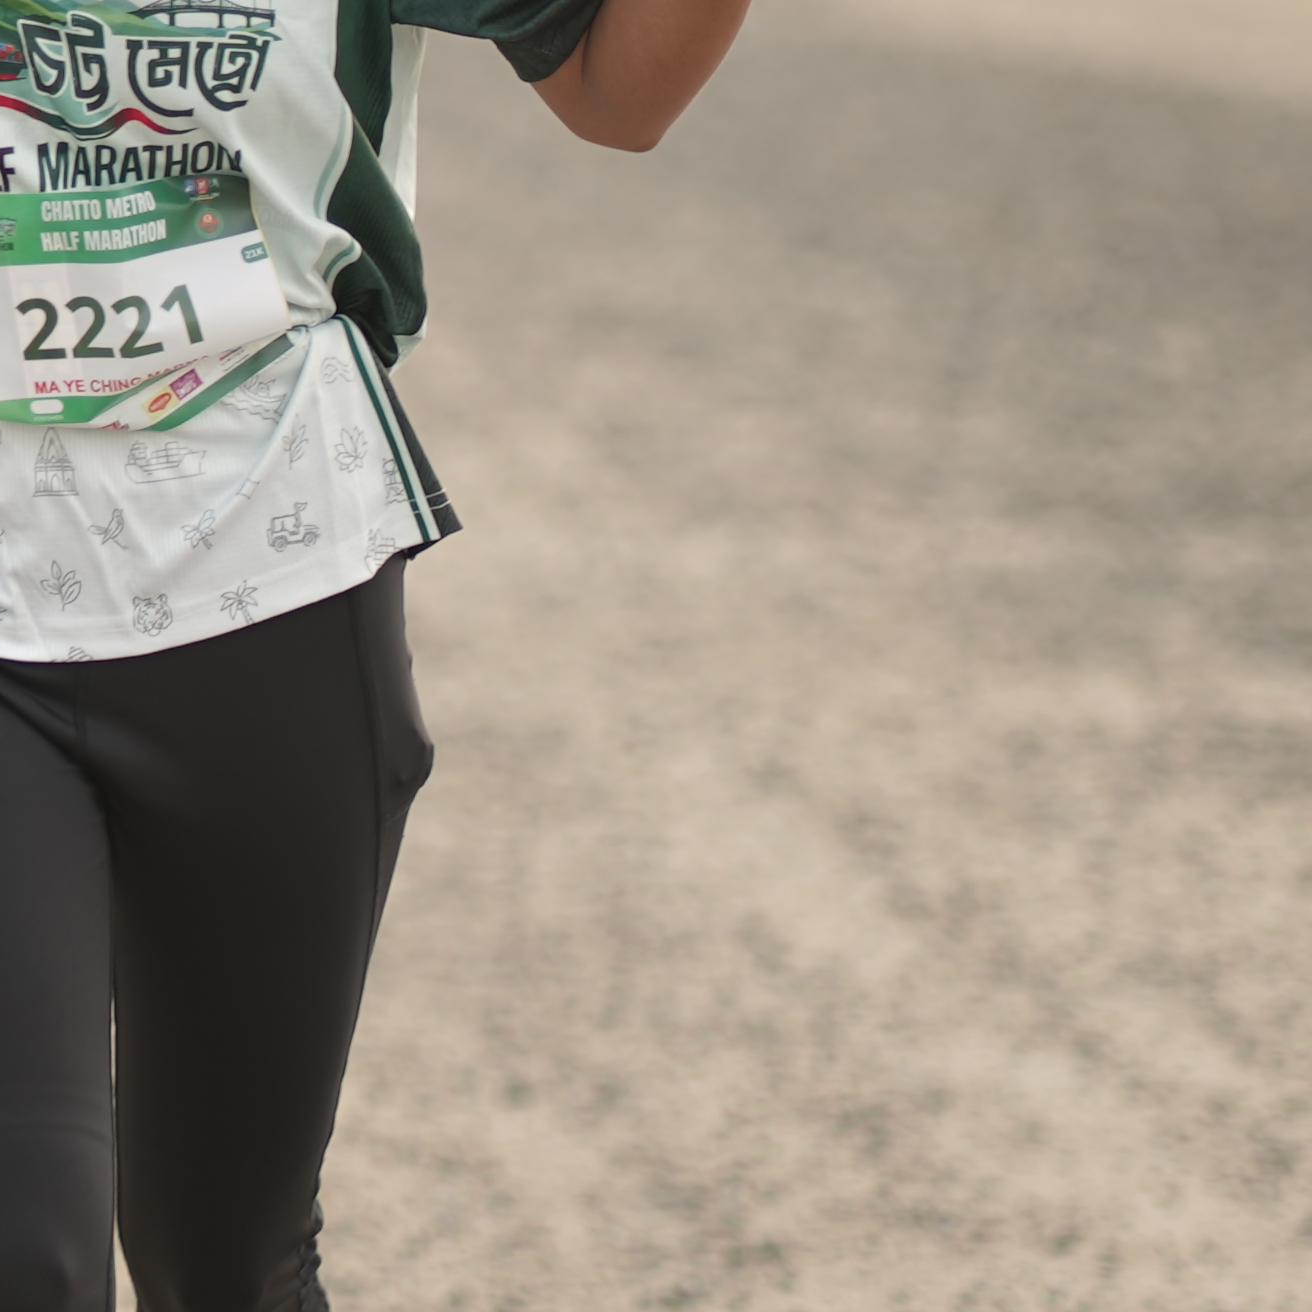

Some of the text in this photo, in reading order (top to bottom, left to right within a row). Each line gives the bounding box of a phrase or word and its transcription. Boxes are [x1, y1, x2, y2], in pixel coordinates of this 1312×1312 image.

[37, 140, 243, 192] MARATHON
[40, 191, 156, 222] CHATTO METRO
[40, 219, 167, 252] HALF MARATHON
[244, 247, 264, 260] 21K
[15, 284, 204, 361] 2221
[34, 381, 60, 394] MA
[63, 380, 86, 393] YE
